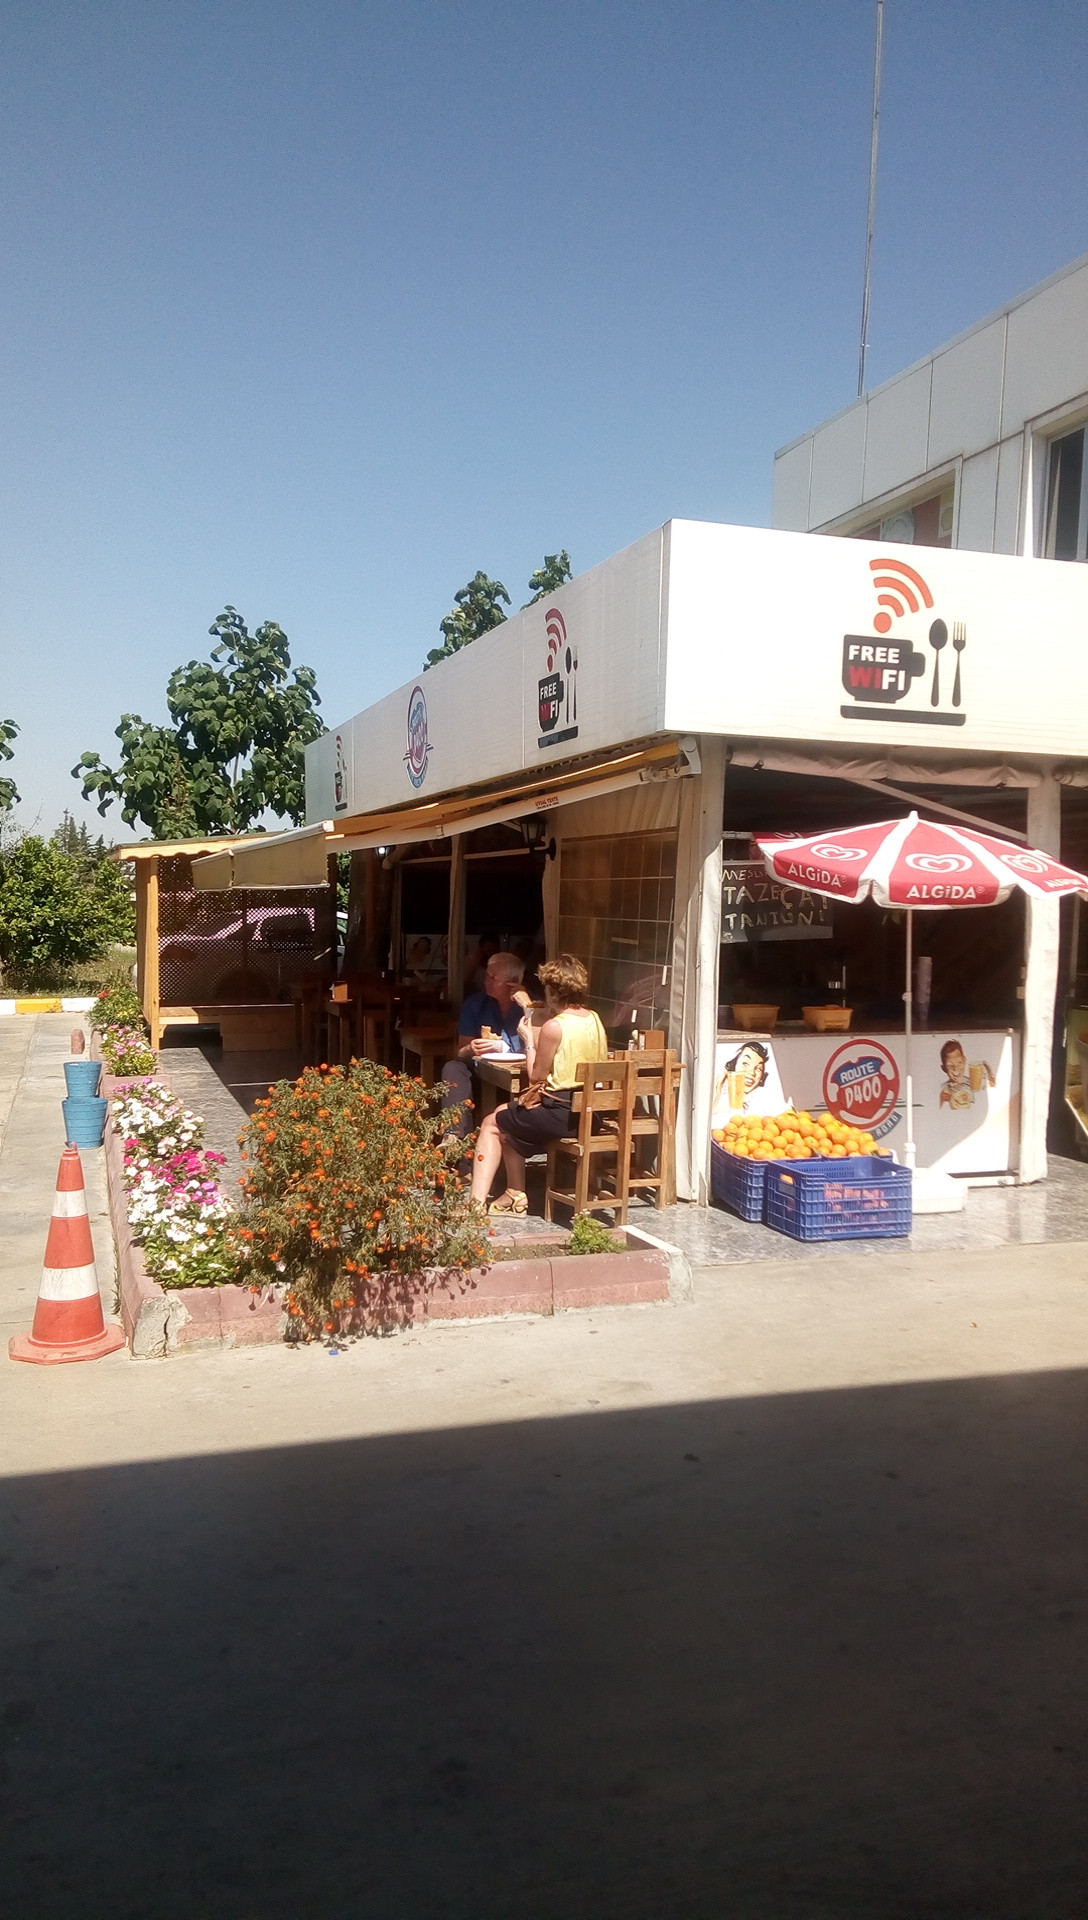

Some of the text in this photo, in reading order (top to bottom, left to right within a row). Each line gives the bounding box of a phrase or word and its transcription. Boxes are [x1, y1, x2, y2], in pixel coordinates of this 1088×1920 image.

[848, 644, 900, 664] FREE
[849, 665, 906, 692] WIFI
[540, 682, 557, 700] FREE
[840, 1062, 875, 1084] ROUTE
[845, 1076, 881, 1109] D400
